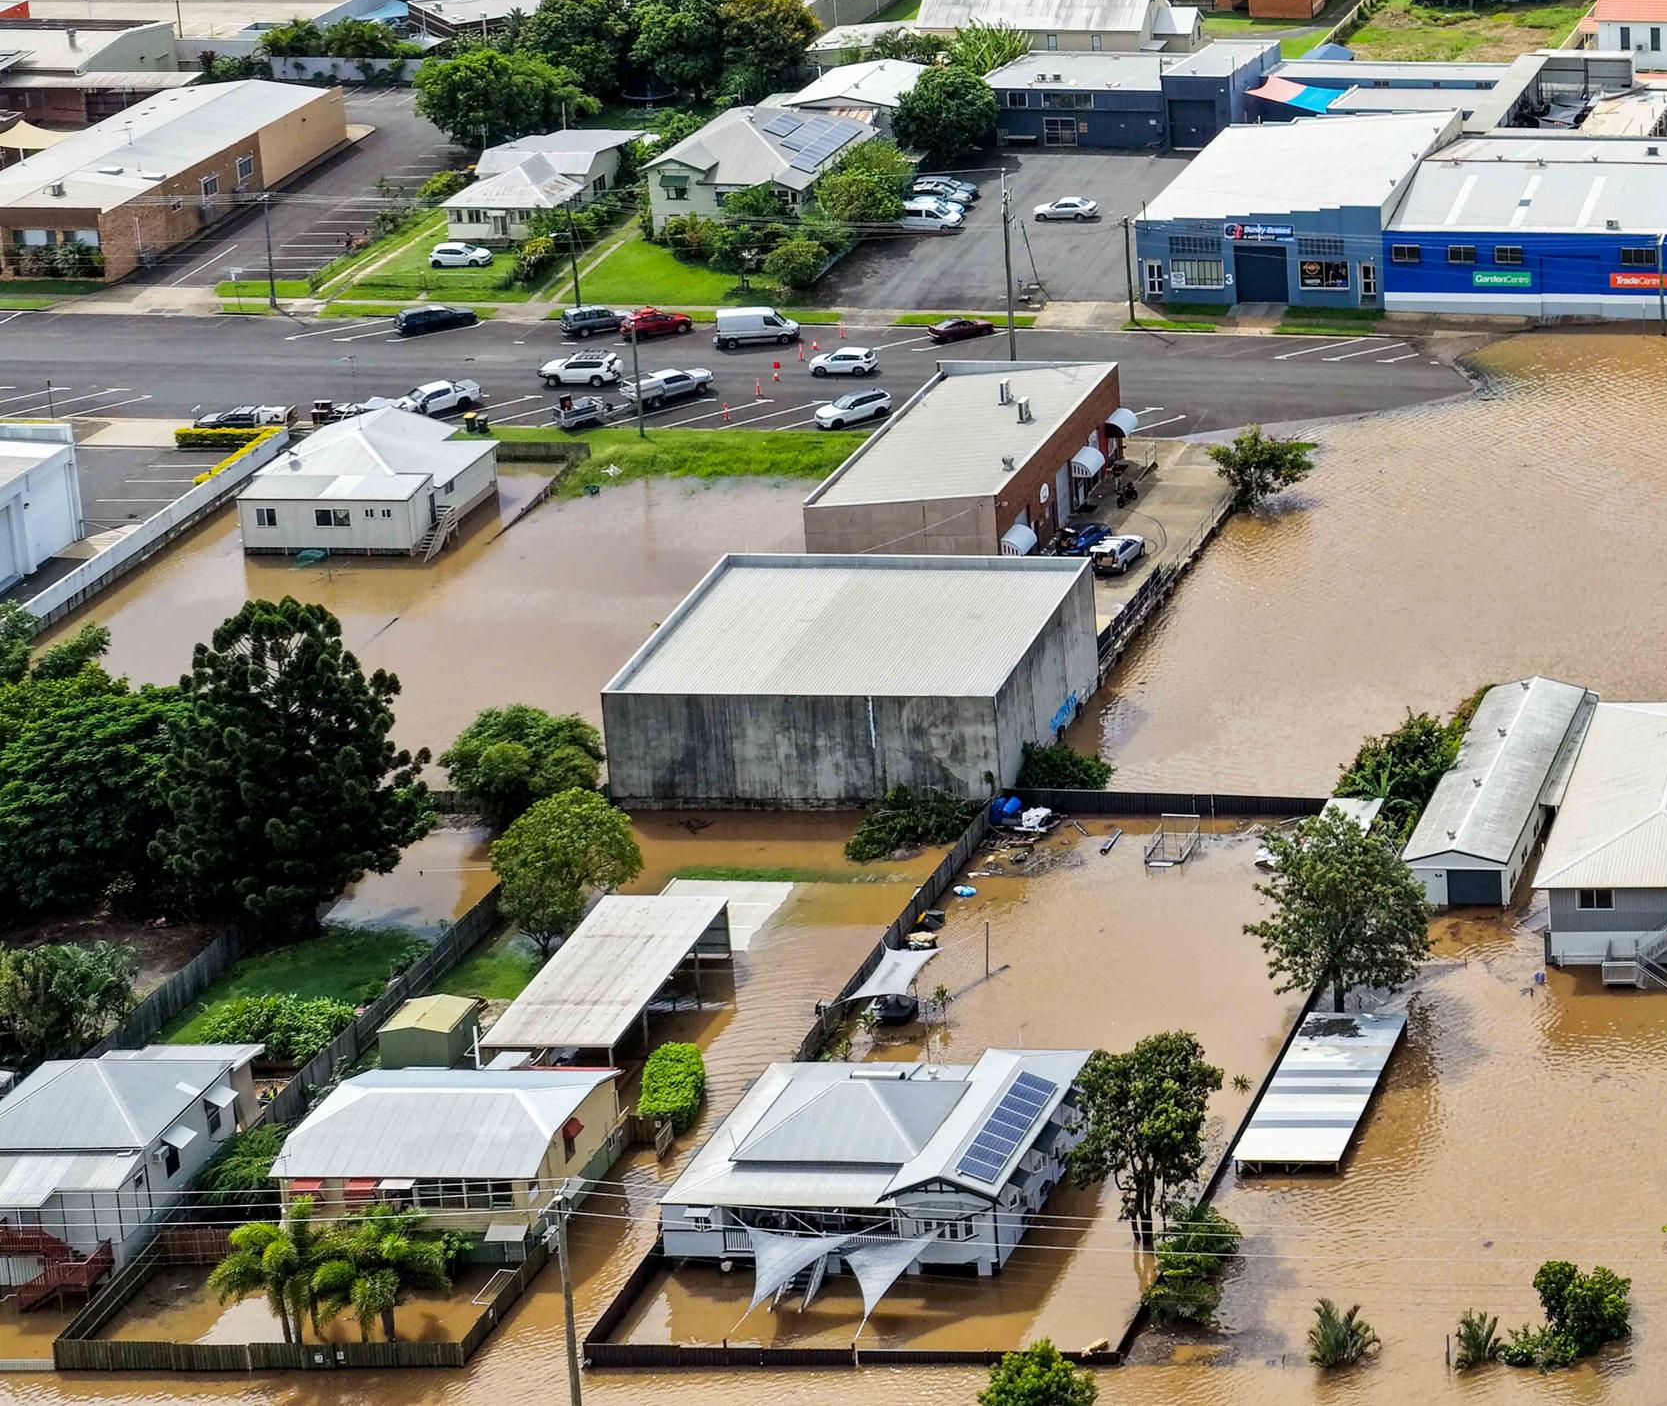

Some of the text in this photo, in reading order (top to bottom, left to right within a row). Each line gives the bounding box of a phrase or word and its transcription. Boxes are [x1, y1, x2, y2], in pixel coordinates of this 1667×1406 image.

[1225, 273, 1234, 285] 3
[1475, 274, 1530, 285] GardenCentre
[1615, 275, 1664, 285] TradeCentr
